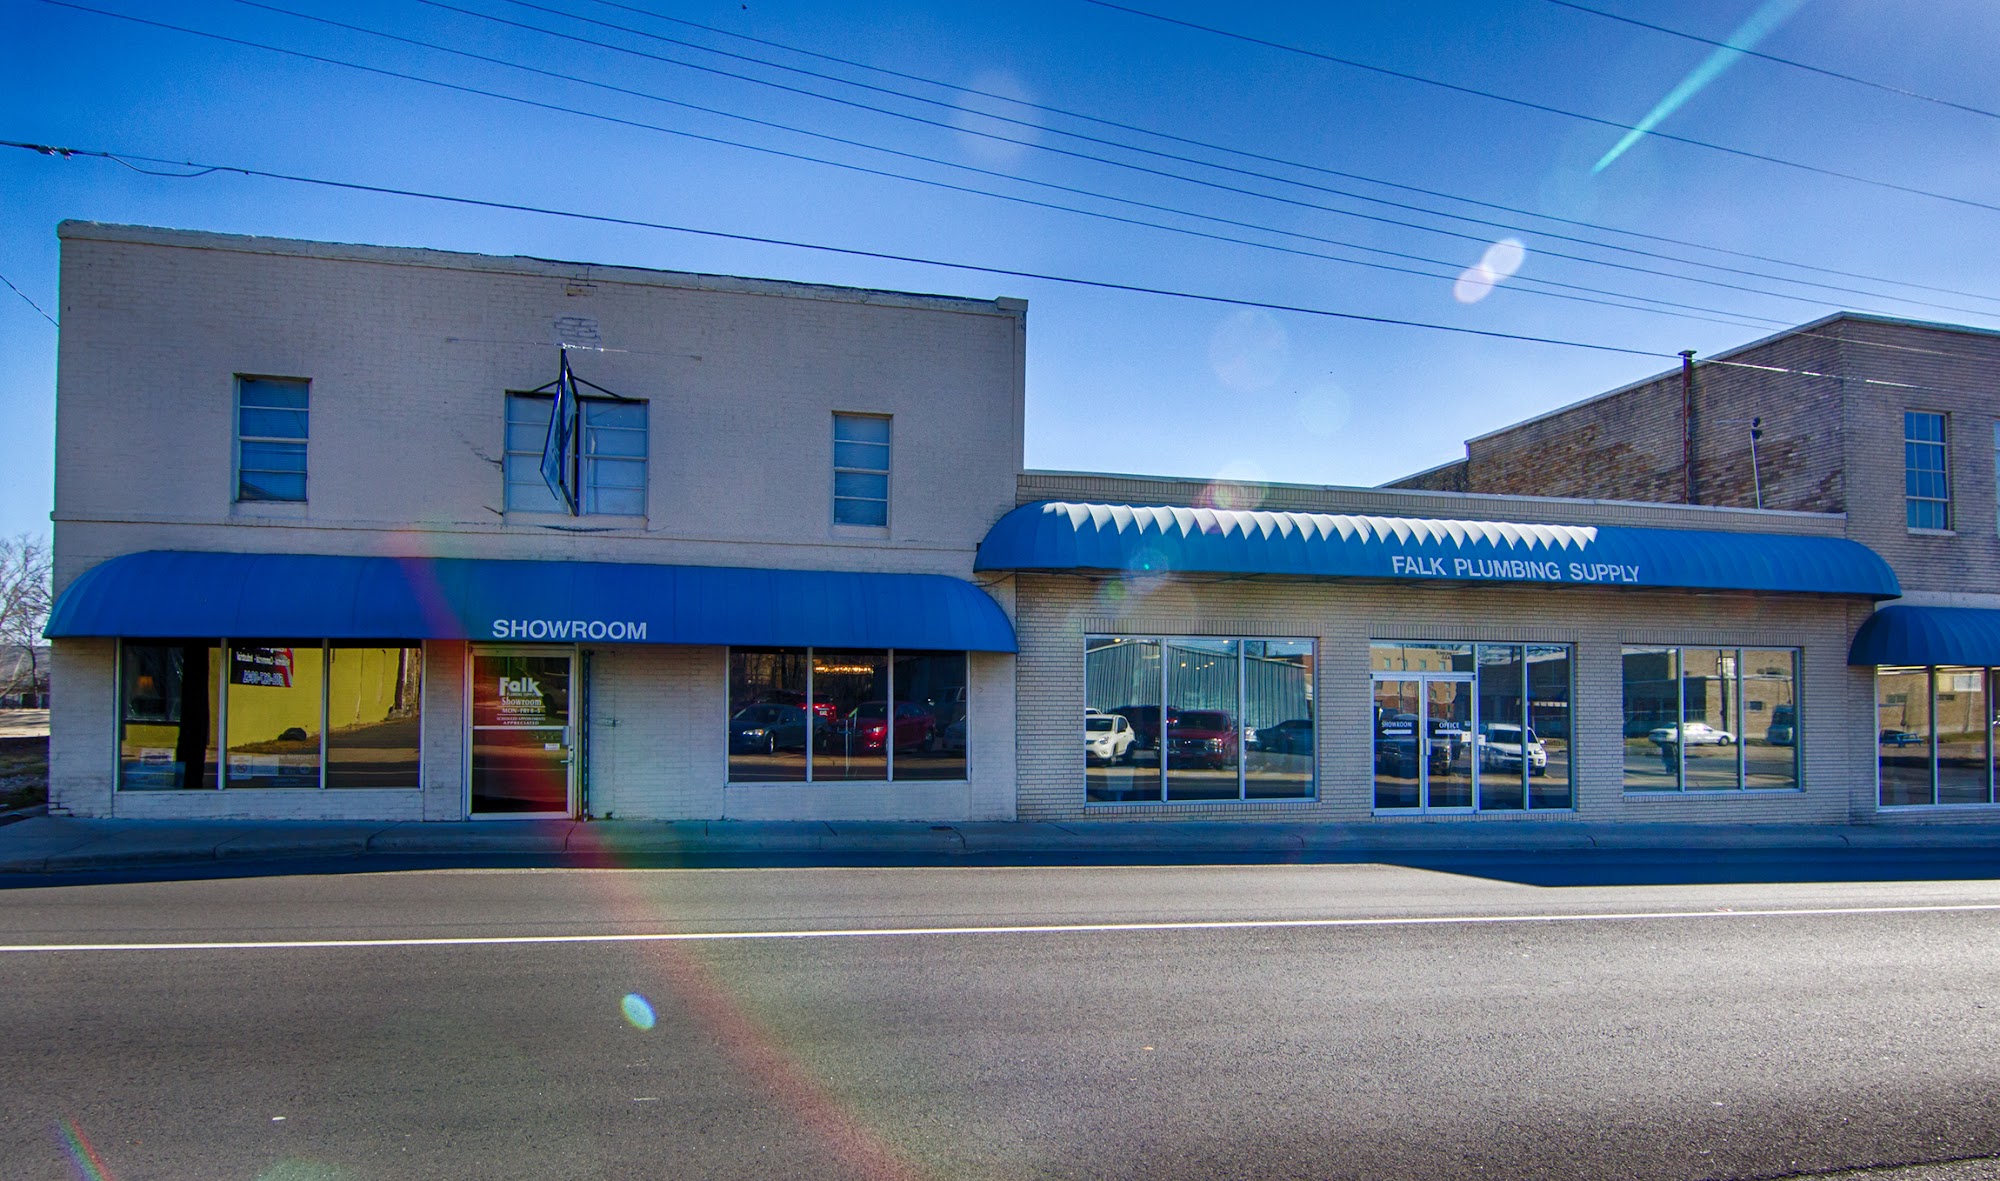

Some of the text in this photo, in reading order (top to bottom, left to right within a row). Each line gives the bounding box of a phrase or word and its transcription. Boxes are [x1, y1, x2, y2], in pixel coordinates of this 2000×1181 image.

[1392, 556, 1640, 582] FALK PLUMBING SUPPLY
[492, 619, 647, 640] SHOWROOM
[499, 677, 544, 697] Falk
[501, 697, 542, 706] Showroom
[1438, 721, 1460, 729] OFFICE
